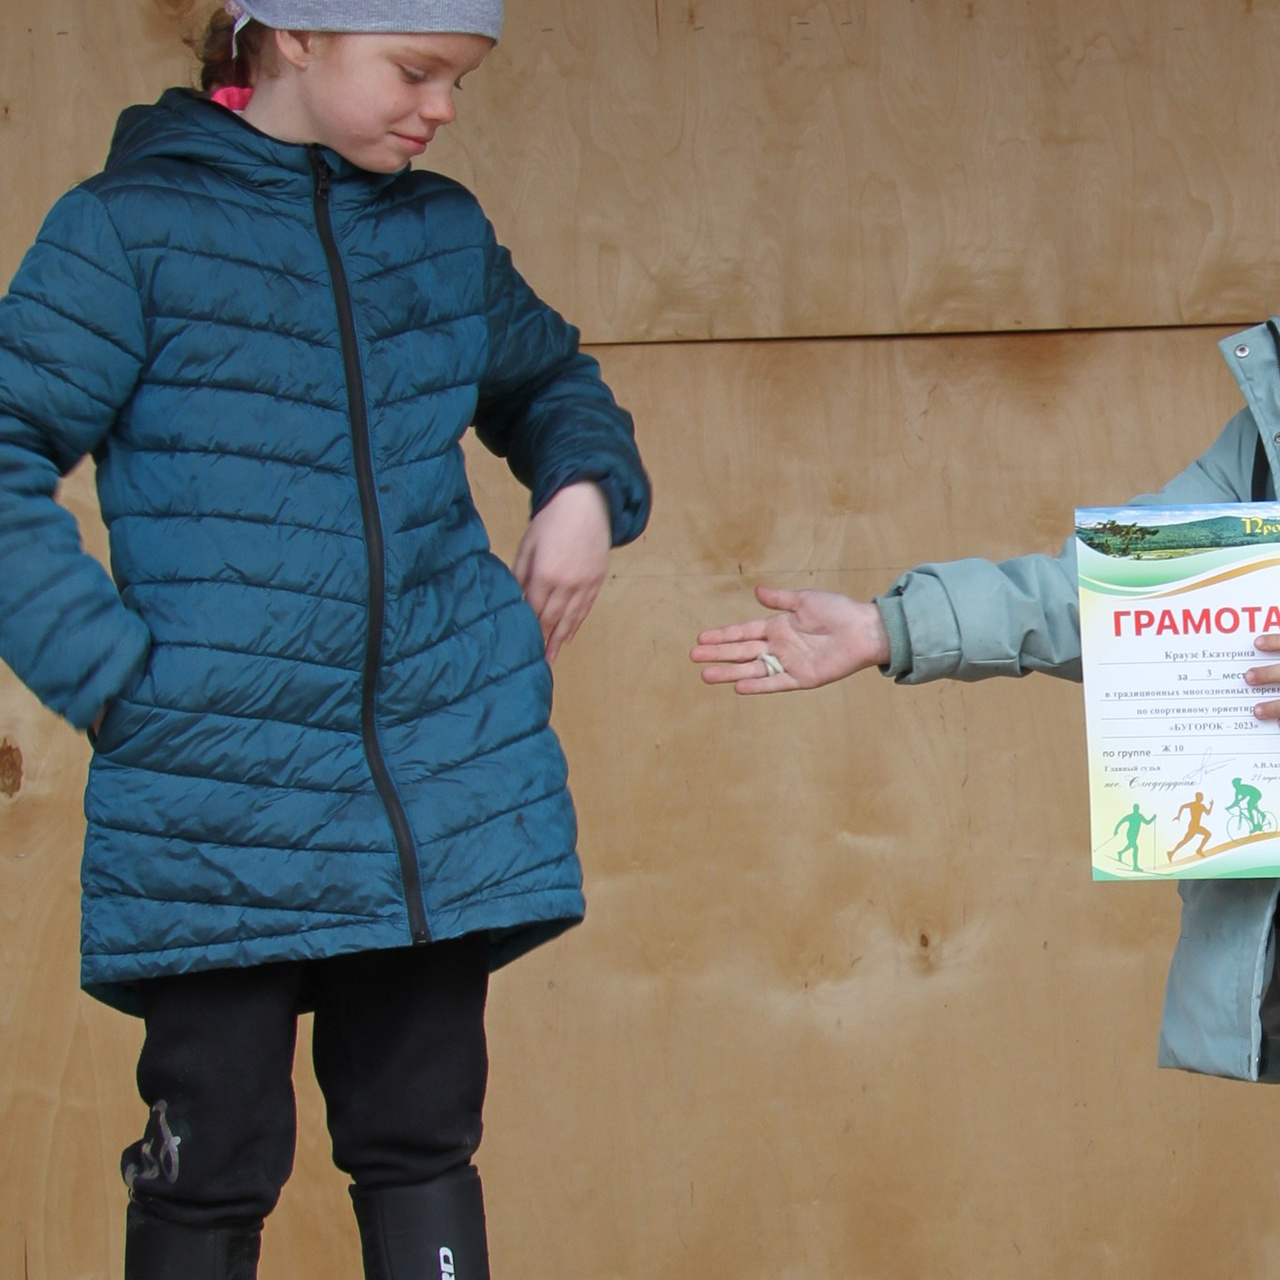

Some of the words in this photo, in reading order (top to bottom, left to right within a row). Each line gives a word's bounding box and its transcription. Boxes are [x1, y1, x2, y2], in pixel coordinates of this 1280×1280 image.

[1164, 651, 1199, 662] Краузе
[1202, 650, 1256, 660] Екатерина
[1222, 672, 1247, 681] мест
[1113, 690, 1180, 700] традиционных
[1150, 706, 1209, 716] спортивному
[1102, 750, 1115, 758] по
[1117, 749, 1151, 759] группе
[1174, 744, 1184, 752] 10
